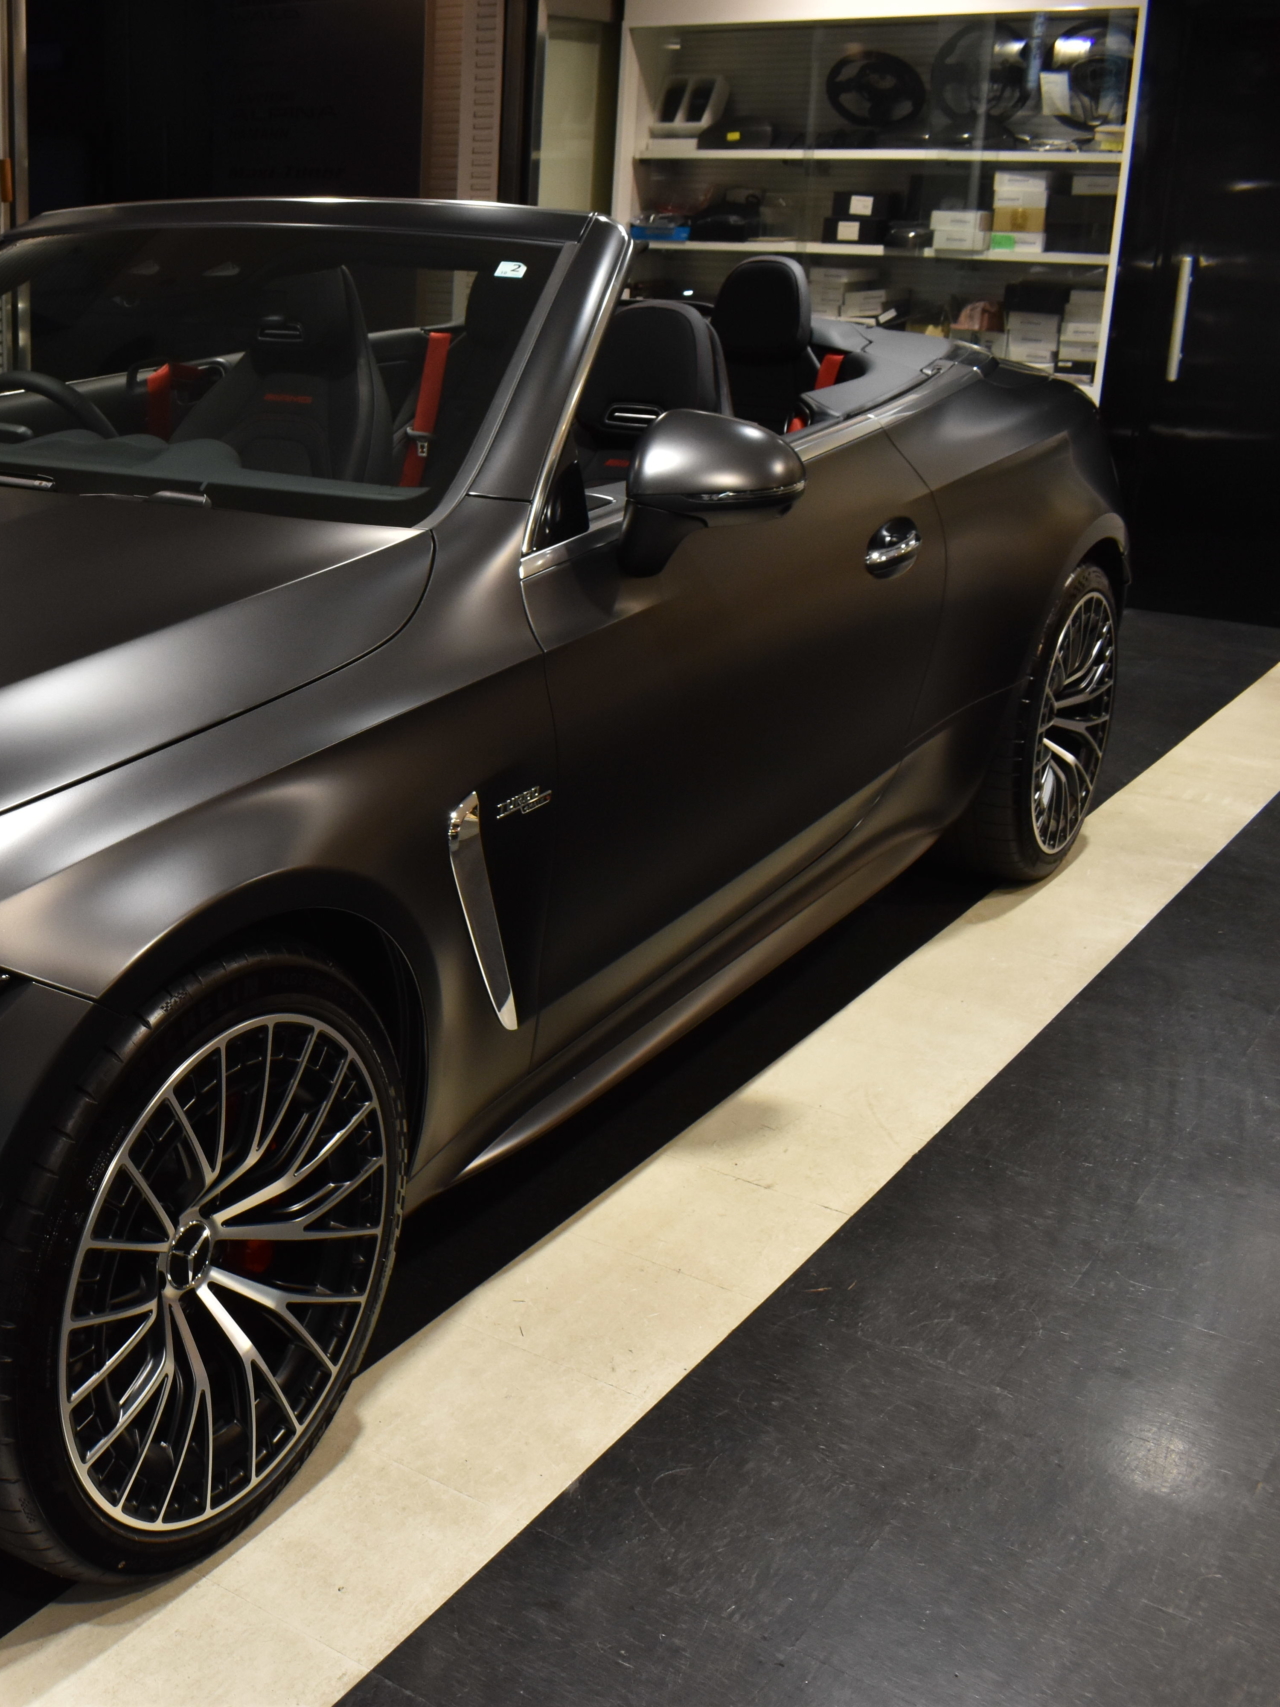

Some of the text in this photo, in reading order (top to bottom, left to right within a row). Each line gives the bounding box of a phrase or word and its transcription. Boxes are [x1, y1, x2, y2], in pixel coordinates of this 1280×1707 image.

[233, 104, 338, 121] ALPINA
[510, 263, 522, 272] 2
[496, 785, 540, 814] TURBO
[271, 972, 306, 986] PILOT
